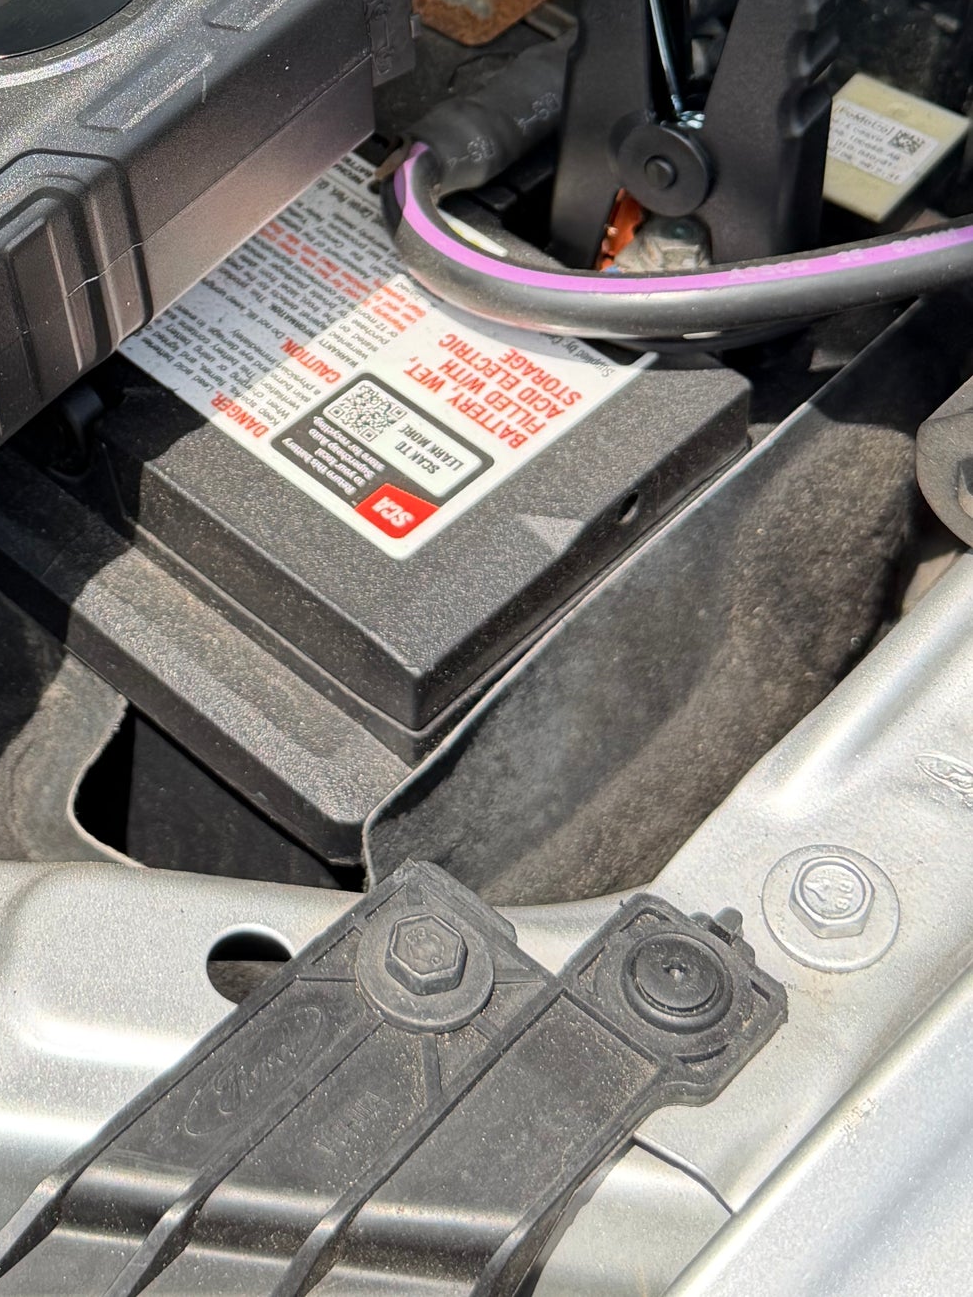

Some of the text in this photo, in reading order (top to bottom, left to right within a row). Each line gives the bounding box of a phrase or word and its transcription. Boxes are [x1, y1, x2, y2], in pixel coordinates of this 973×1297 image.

[161, 321, 194, 346] battery
[177, 349, 198, 365] and
[207, 341, 241, 366] battery
[215, 362, 229, 372] or
[250, 359, 271, 375] and
[275, 336, 343, 385] CAUTION.
[316, 337, 359, 368] WARRANTY
[571, 348, 616, 378] Supplied
[138, 335, 271, 439] DANGER. Lead acid batteries
[436, 331, 566, 422] ACID ELECTRIC
[497, 346, 584, 408] STORAGE
[263, 398, 291, 419] When
[397, 355, 529, 450] BATTERY, WET,
[438, 358, 547, 435] FILLED WITH
[254, 406, 282, 426] Keep
[309, 413, 387, 472] store for recycling.
[393, 440, 413, 455] TO
[397, 422, 432, 448] MORE
[279, 435, 358, 496] Return this battery
[305, 426, 377, 480] Supercheap Auto
[312, 446, 366, 487] to your local
[370, 494, 416, 530] SCA
